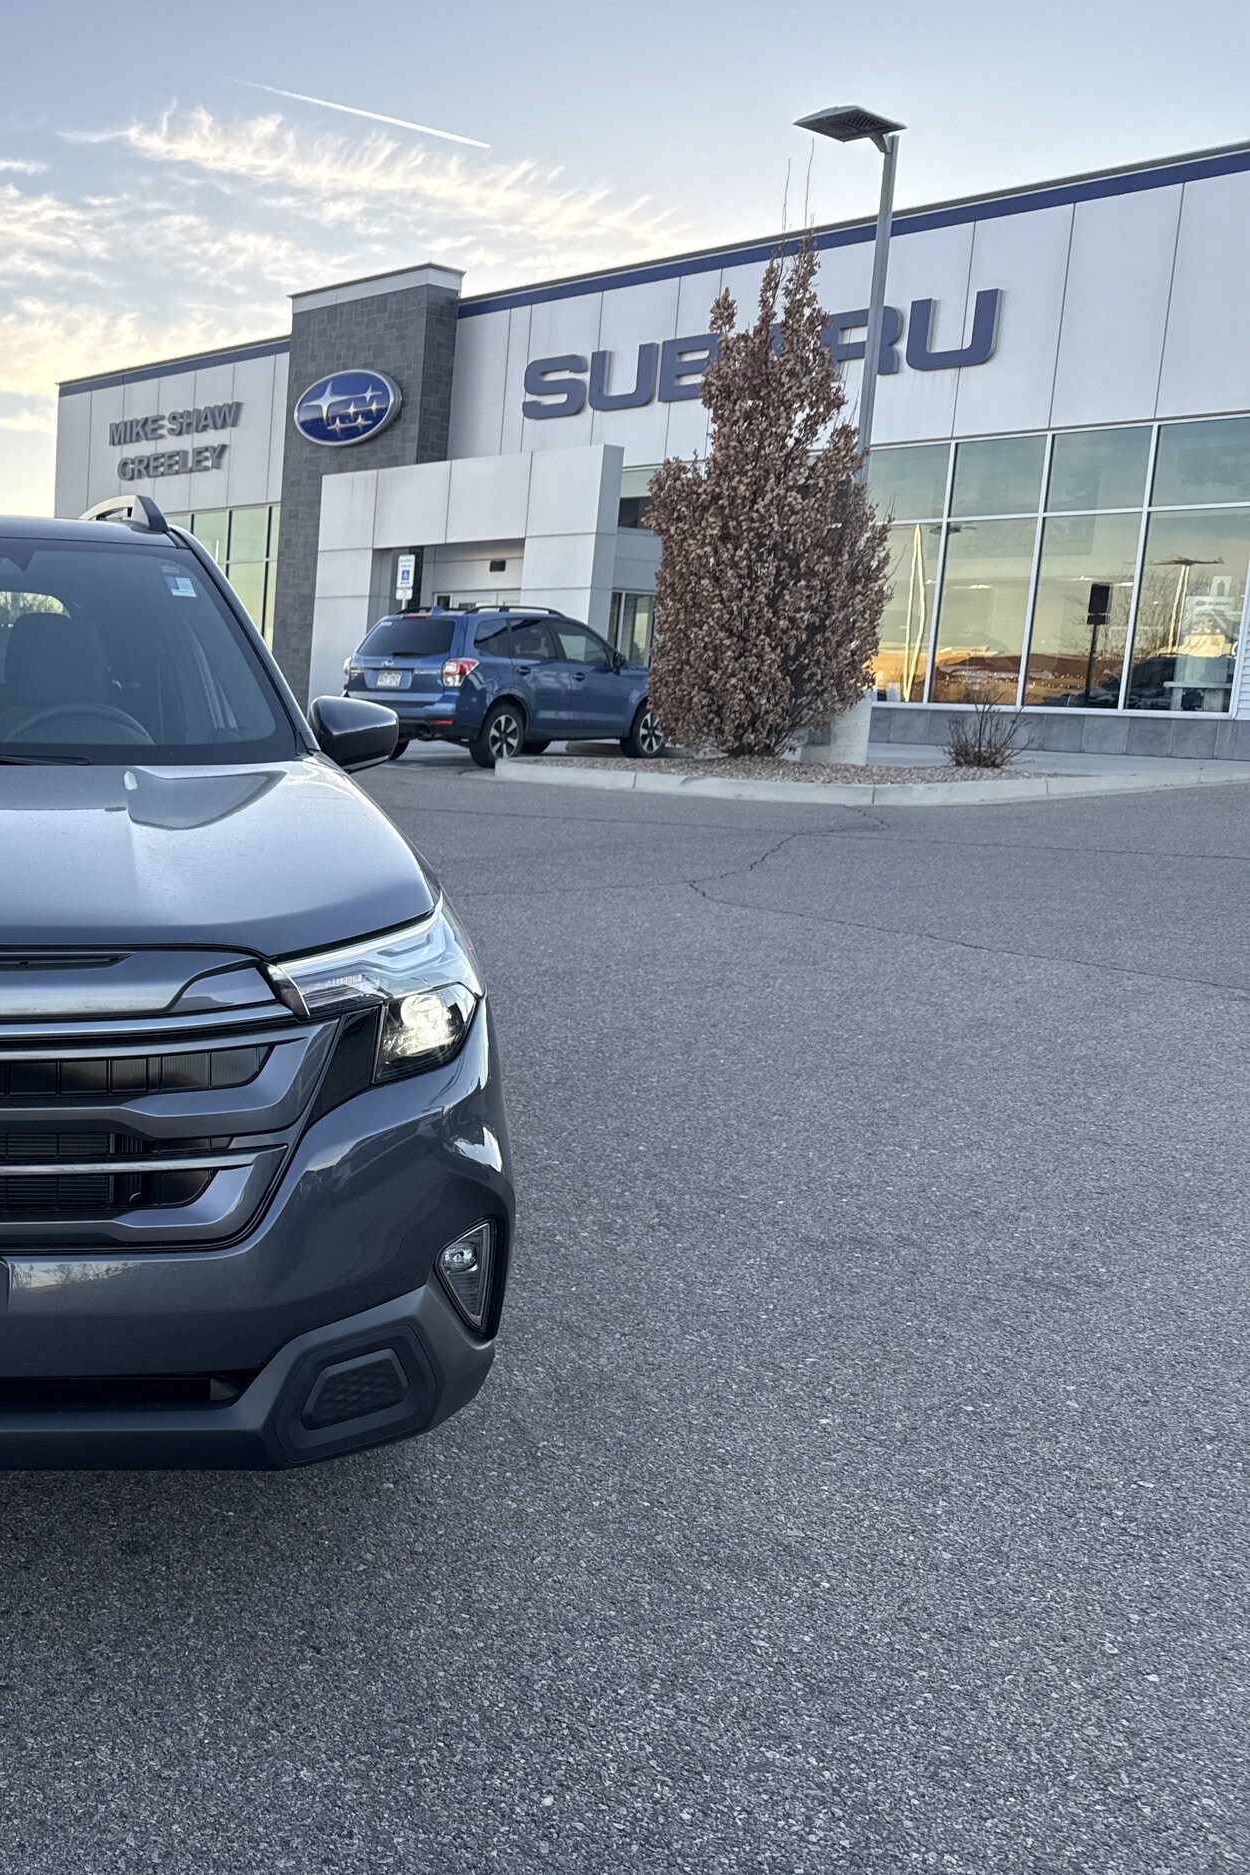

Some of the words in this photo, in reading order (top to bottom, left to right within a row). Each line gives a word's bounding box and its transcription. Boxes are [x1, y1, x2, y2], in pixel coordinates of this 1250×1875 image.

[522, 288, 1003, 420] SUBRU
[108, 415, 166, 446] MIKE
[167, 401, 243, 436] SHAW
[117, 443, 229, 481] GREELEY
